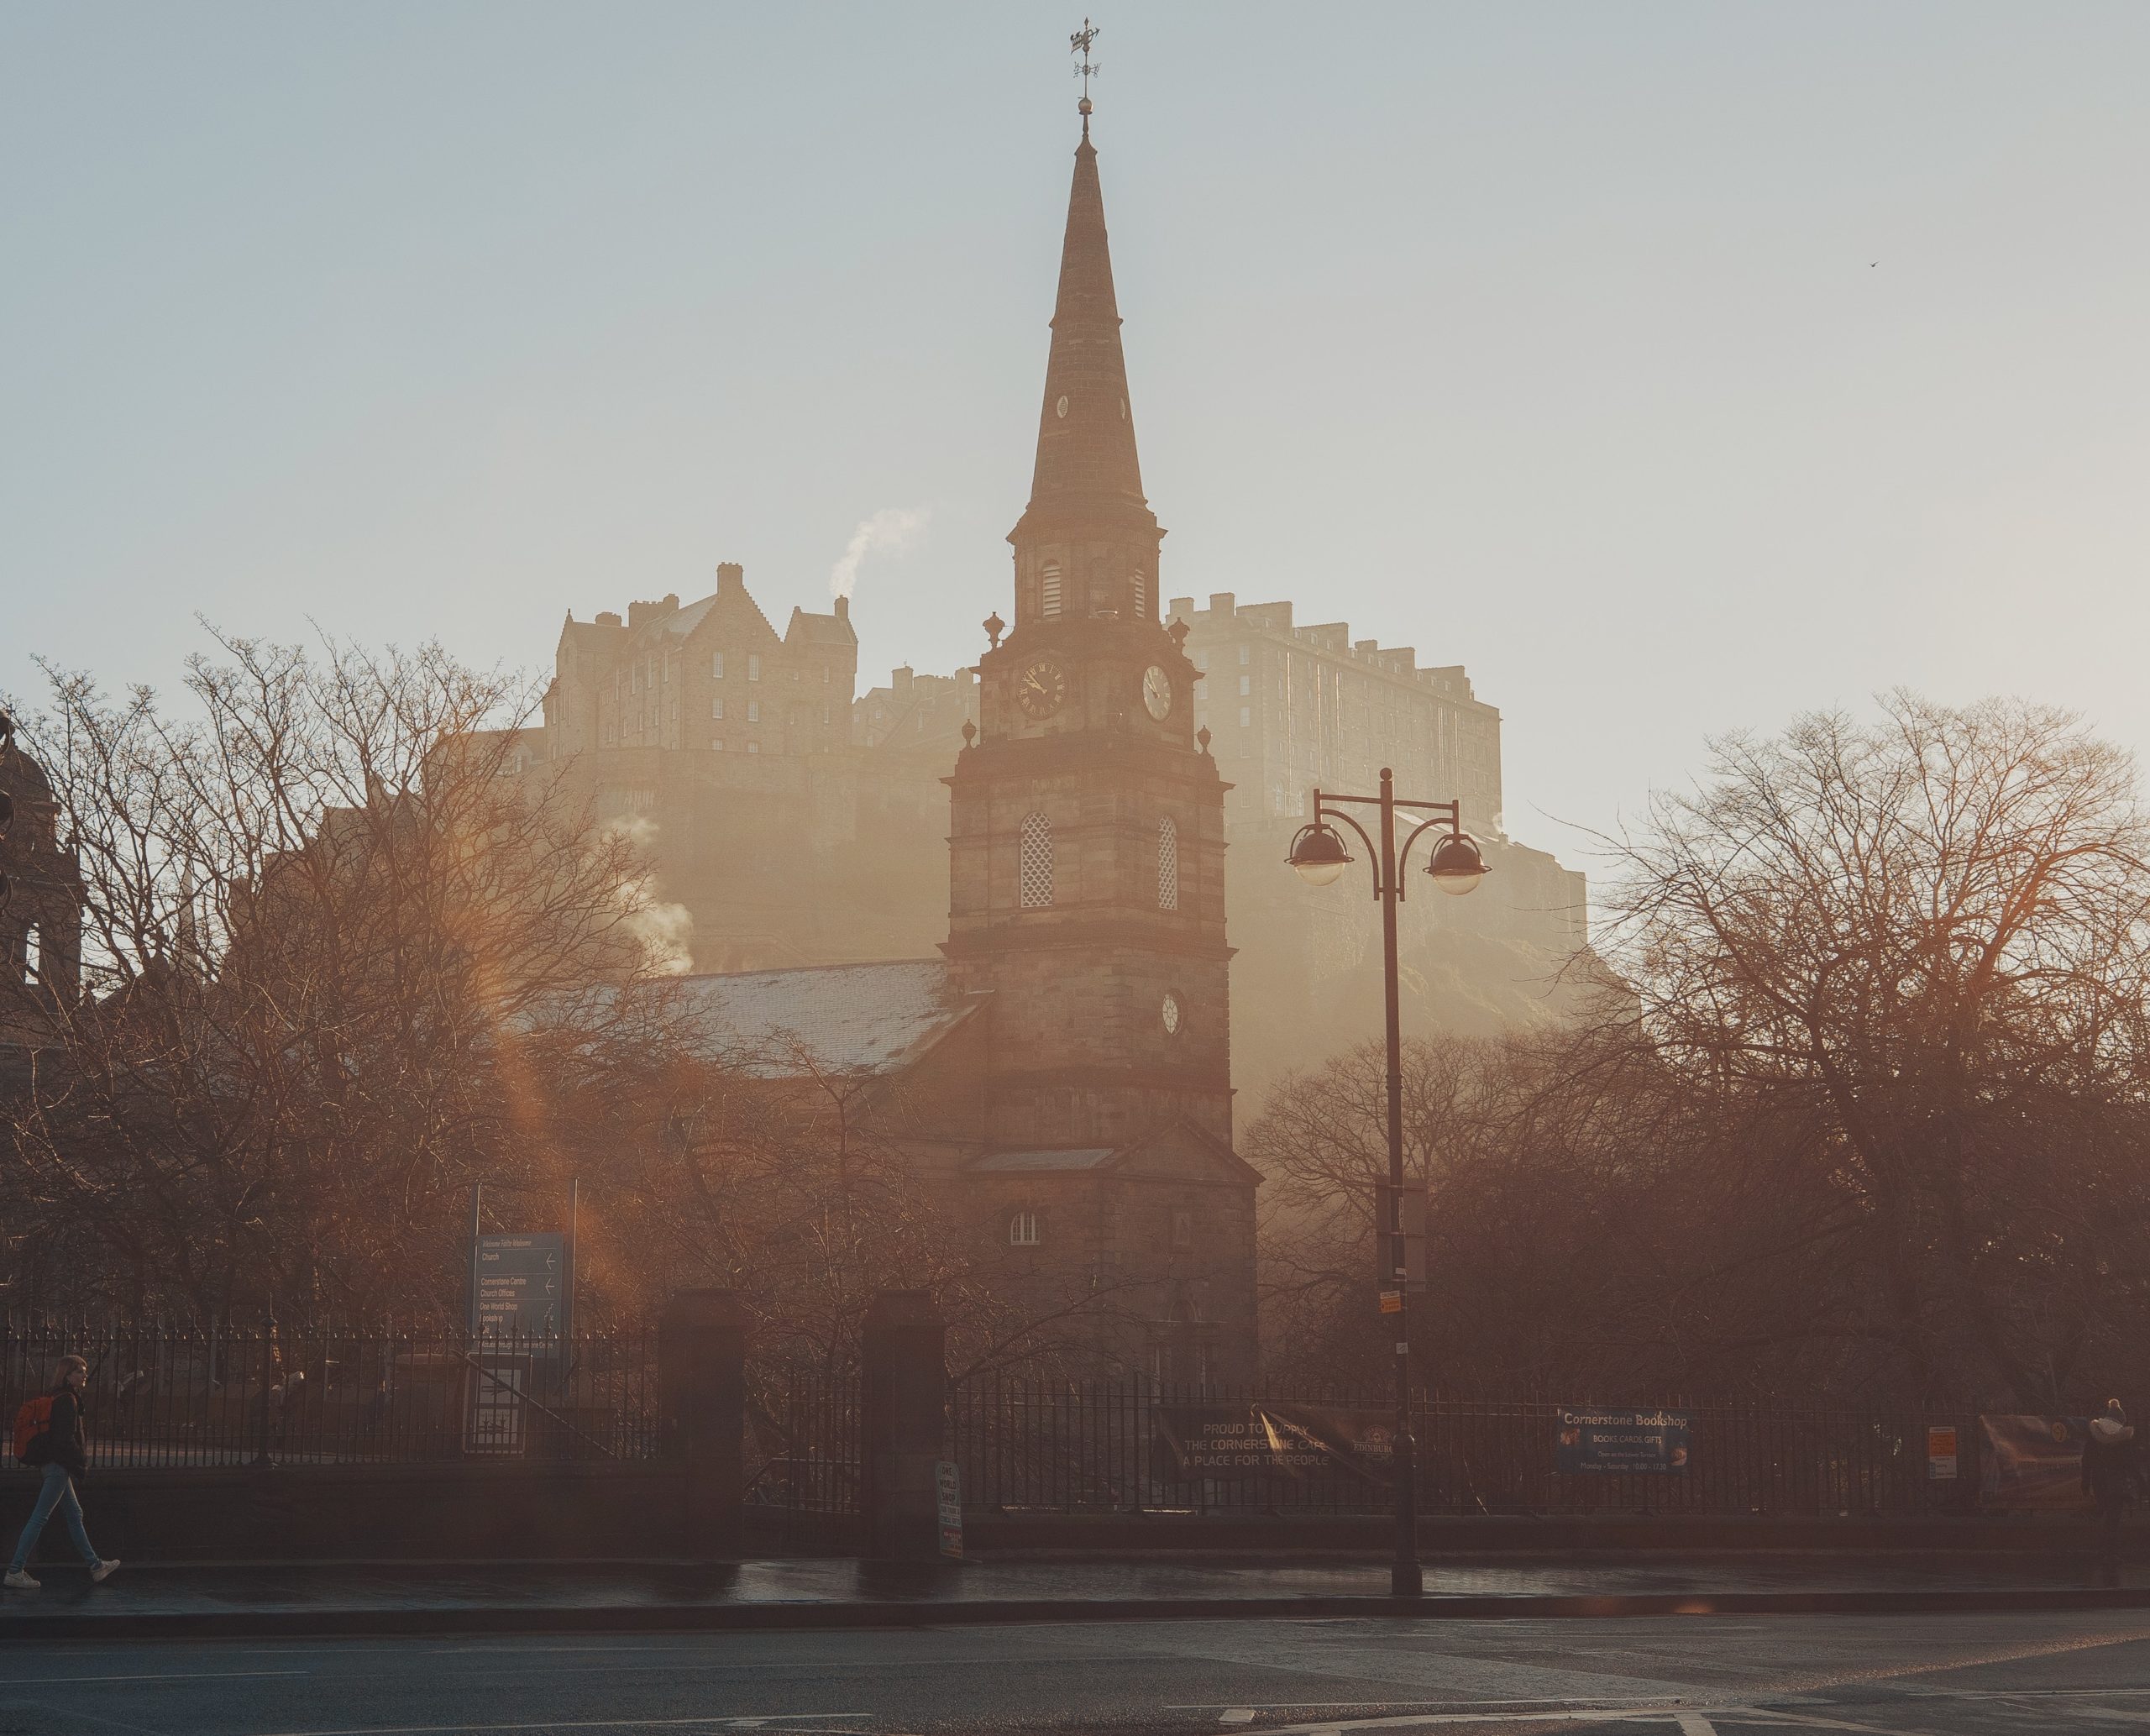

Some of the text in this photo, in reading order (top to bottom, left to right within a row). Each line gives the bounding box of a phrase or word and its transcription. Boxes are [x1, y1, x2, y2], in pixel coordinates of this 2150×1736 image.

[482, 1252, 500, 1261] Church
[481, 1277, 527, 1286] Cornerstone Centre
[480, 1288, 516, 1298] Church Offices
[505, 1302, 518, 1311] Shop
[480, 1314, 503, 1324] ookshp
[1565, 1413, 1687, 1430] Cornerstone Bookshop
[1203, 1424, 1309, 1435] PROUD TO UPPLY
[1185, 1440, 1207, 1451] THE
[1211, 1440, 1294, 1450] CORNERSNE
[1644, 1436, 1662, 1445] GIFTS
[1183, 1455, 1330, 1466] A PLACE FOR THE PEOPLE
[942, 1466, 952, 1476] ONE
[1581, 1462, 1602, 1471] Monday
[939, 1479, 957, 1490] WORLD
[942, 1492, 956, 1502] SHOP
